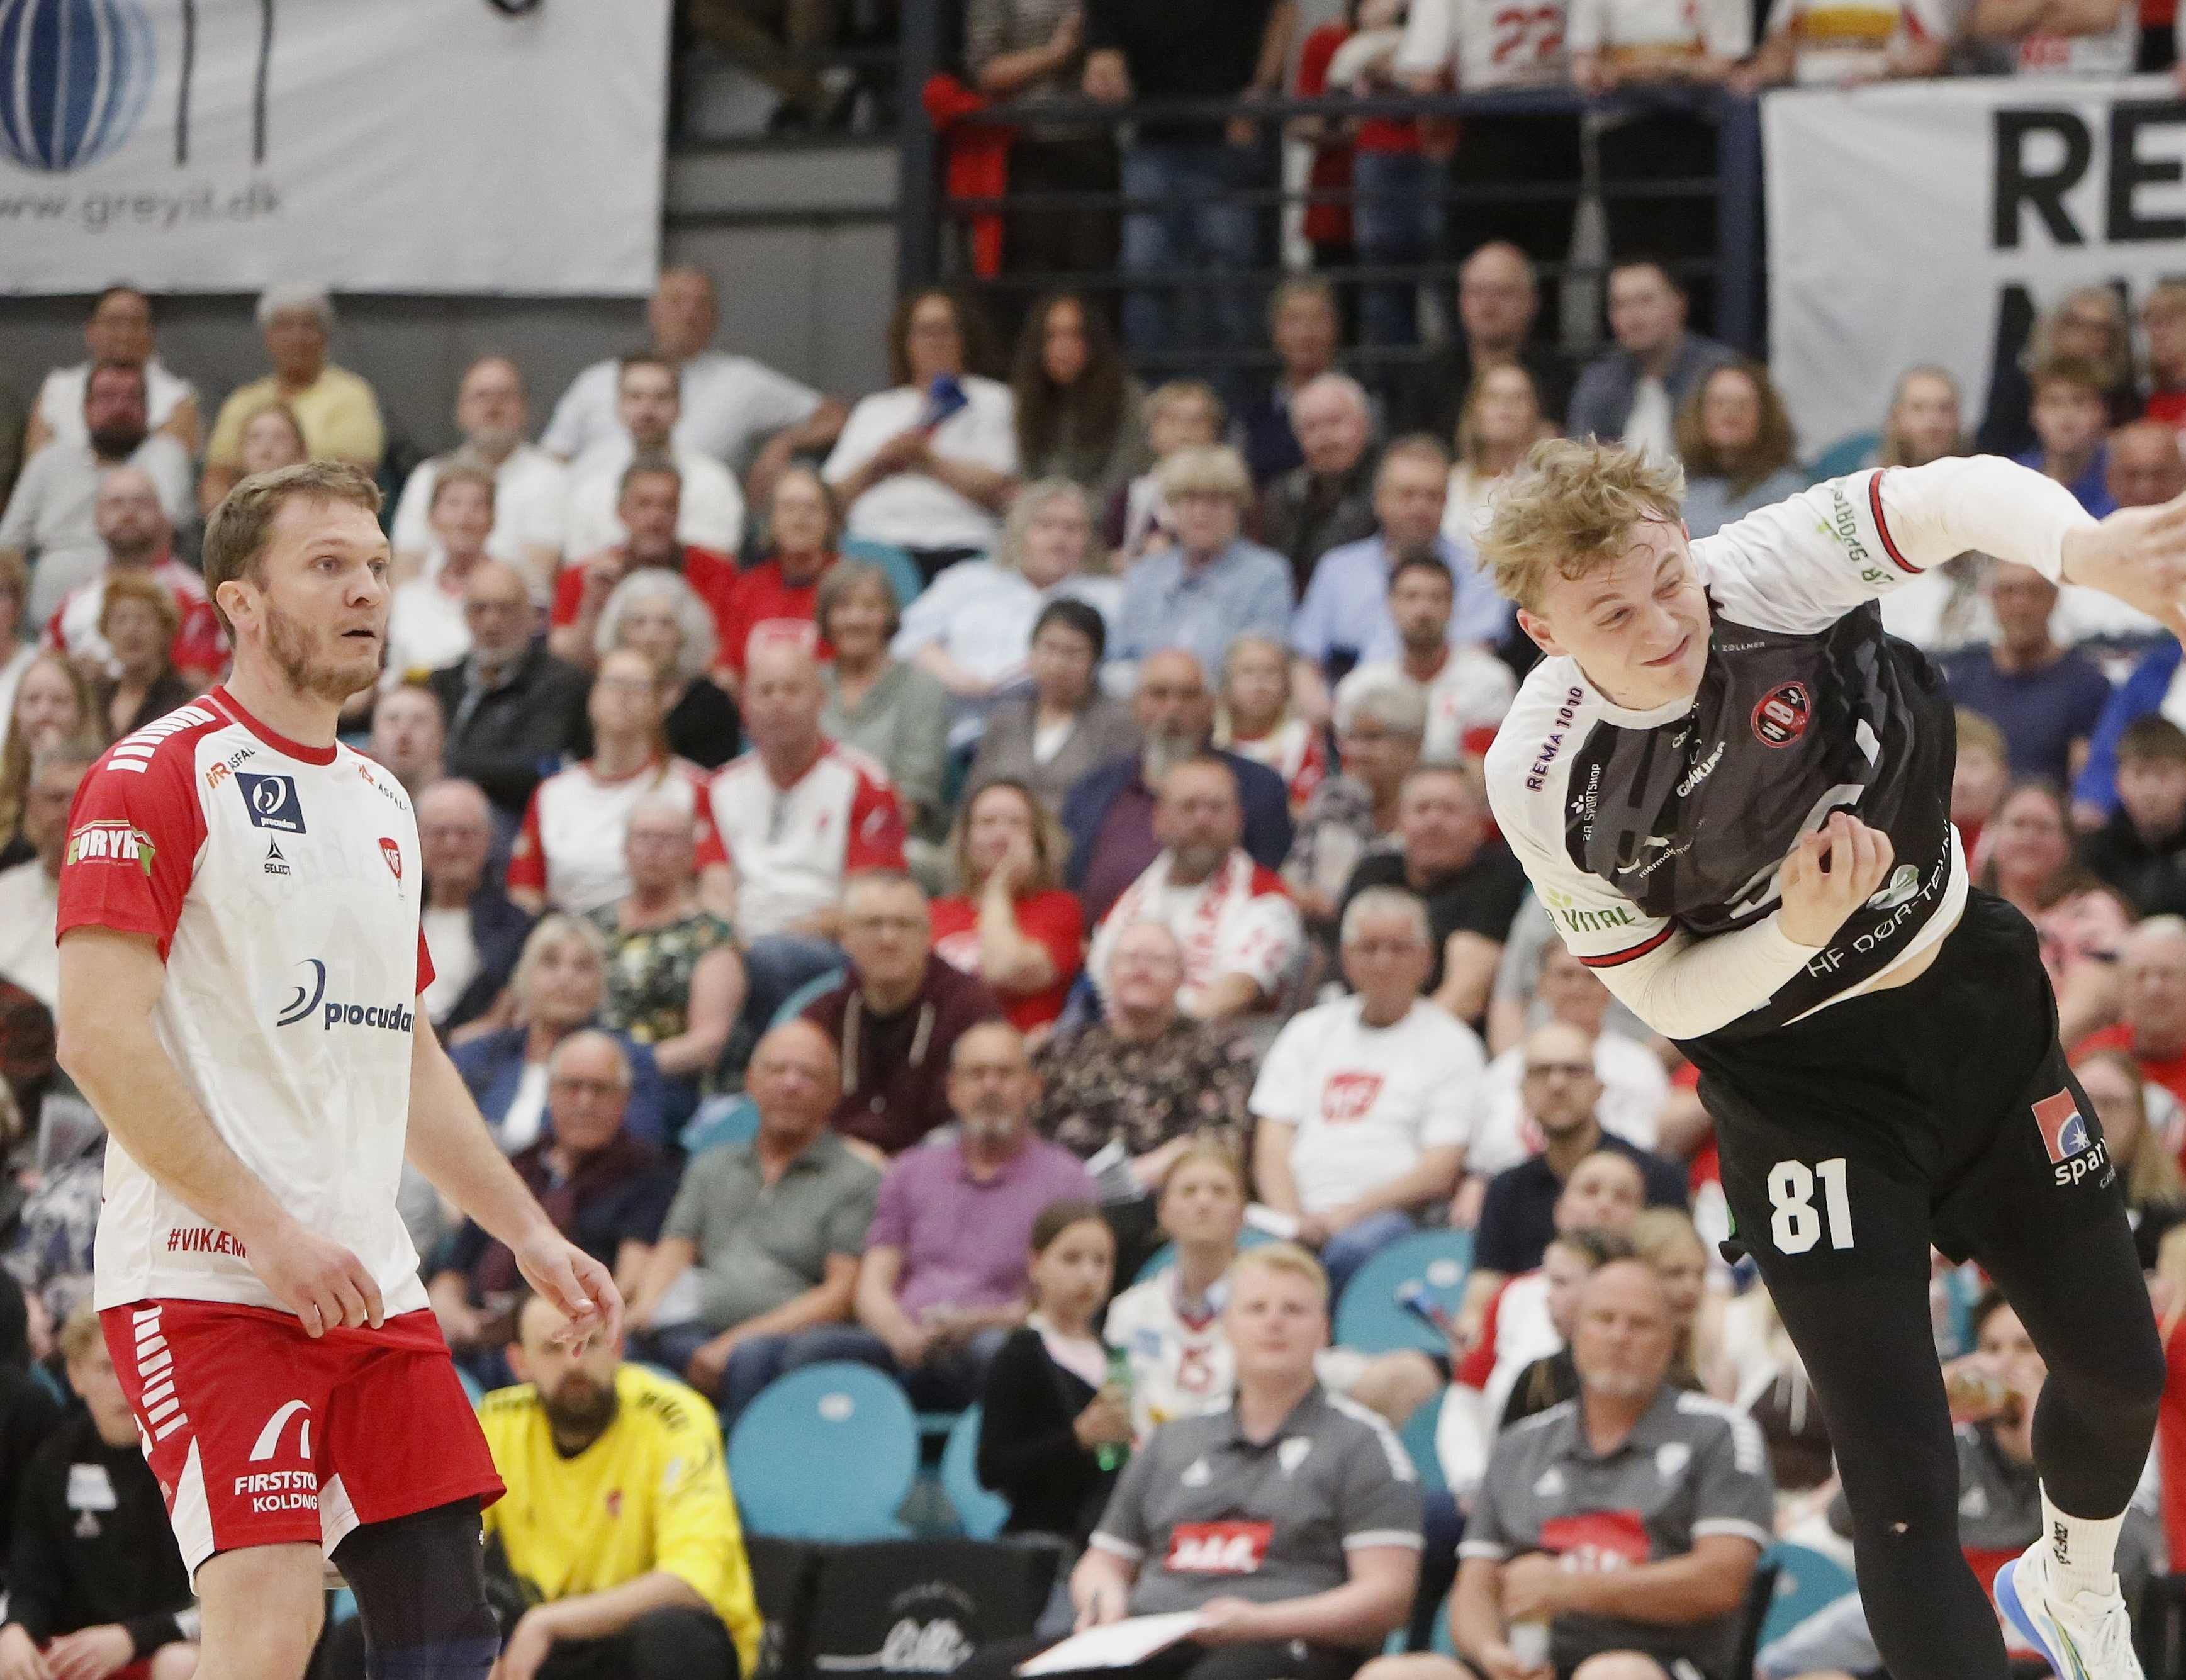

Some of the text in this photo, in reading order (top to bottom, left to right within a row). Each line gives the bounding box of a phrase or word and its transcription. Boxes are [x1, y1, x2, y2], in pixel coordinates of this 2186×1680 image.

[1525, 686, 1584, 792] REMA 1000
[228, 747, 256, 770] ASFAL
[378, 783, 408, 810] ASFAL
[1583, 764, 1601, 823] SPORTSHOP
[264, 863, 291, 875] SELECT
[384, 848, 400, 874] KIF
[1561, 906, 1635, 932] VITAL
[1807, 948, 1844, 977] HF
[1767, 1158, 1855, 1255] 81
[234, 1470, 318, 1496] FIRSTSTO
[253, 1493, 318, 1513] KOLDNG
